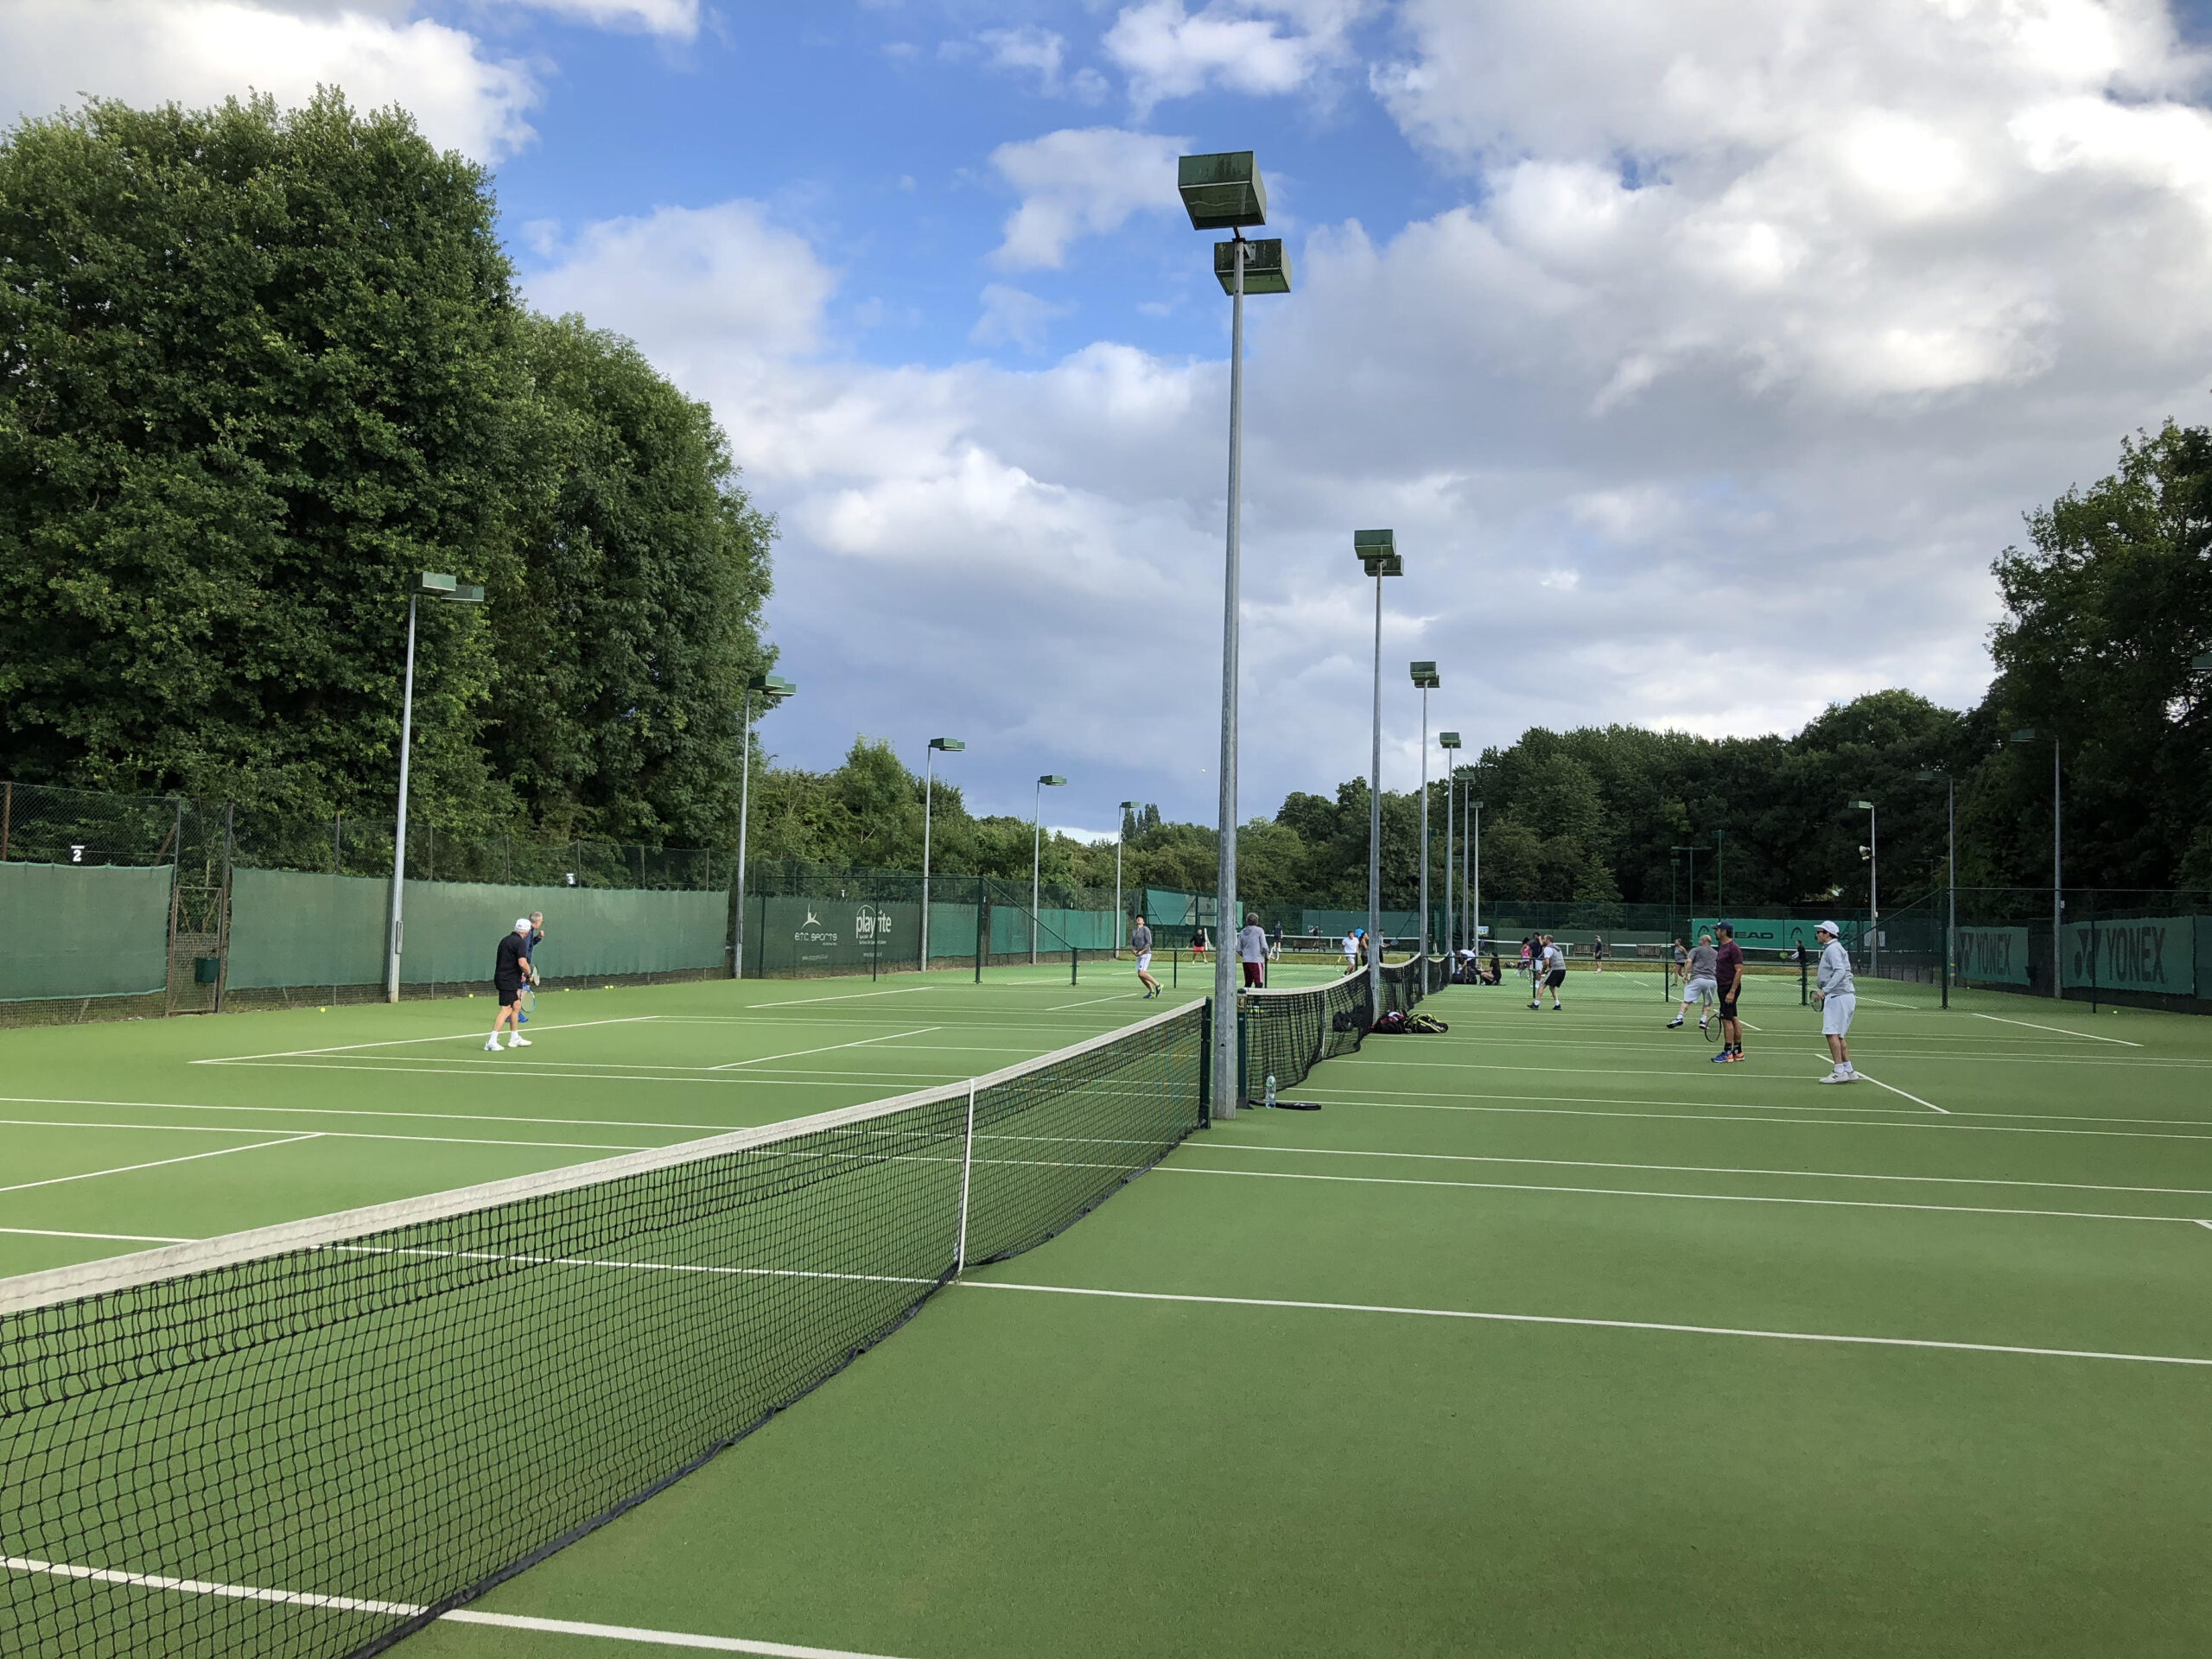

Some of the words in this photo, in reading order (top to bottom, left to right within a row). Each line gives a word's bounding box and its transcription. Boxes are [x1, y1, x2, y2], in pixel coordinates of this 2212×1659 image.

[73, 849, 81, 861] 2
[1976, 932, 2012, 976] YONEX
[2106, 926, 2166, 984] YONEX
